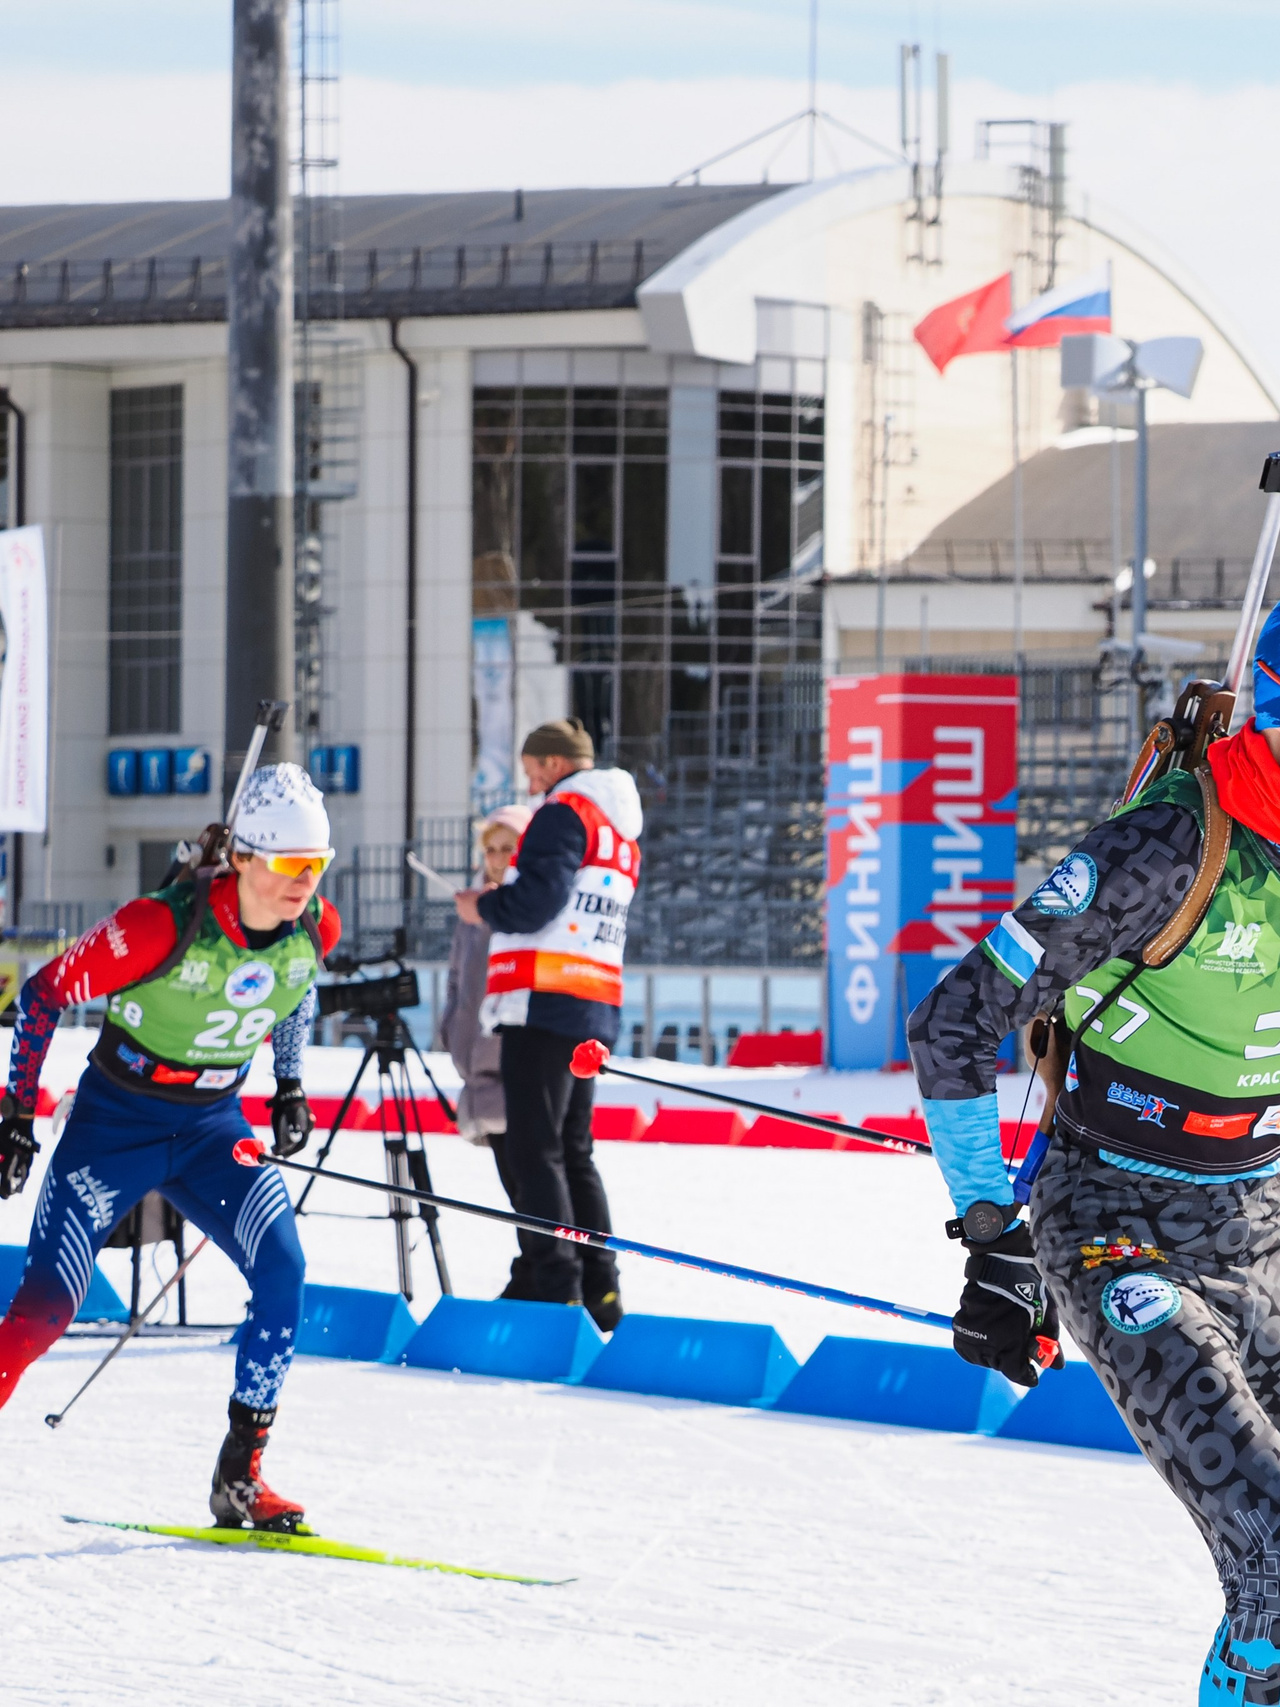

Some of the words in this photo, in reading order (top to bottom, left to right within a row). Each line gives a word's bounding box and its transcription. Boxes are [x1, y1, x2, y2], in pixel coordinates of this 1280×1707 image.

[845, 726, 883, 1024] ФИНИШ
[931, 726, 986, 984] ИНИШ
[193, 1007, 277, 1050] 28
[1075, 985, 1151, 1045] 27
